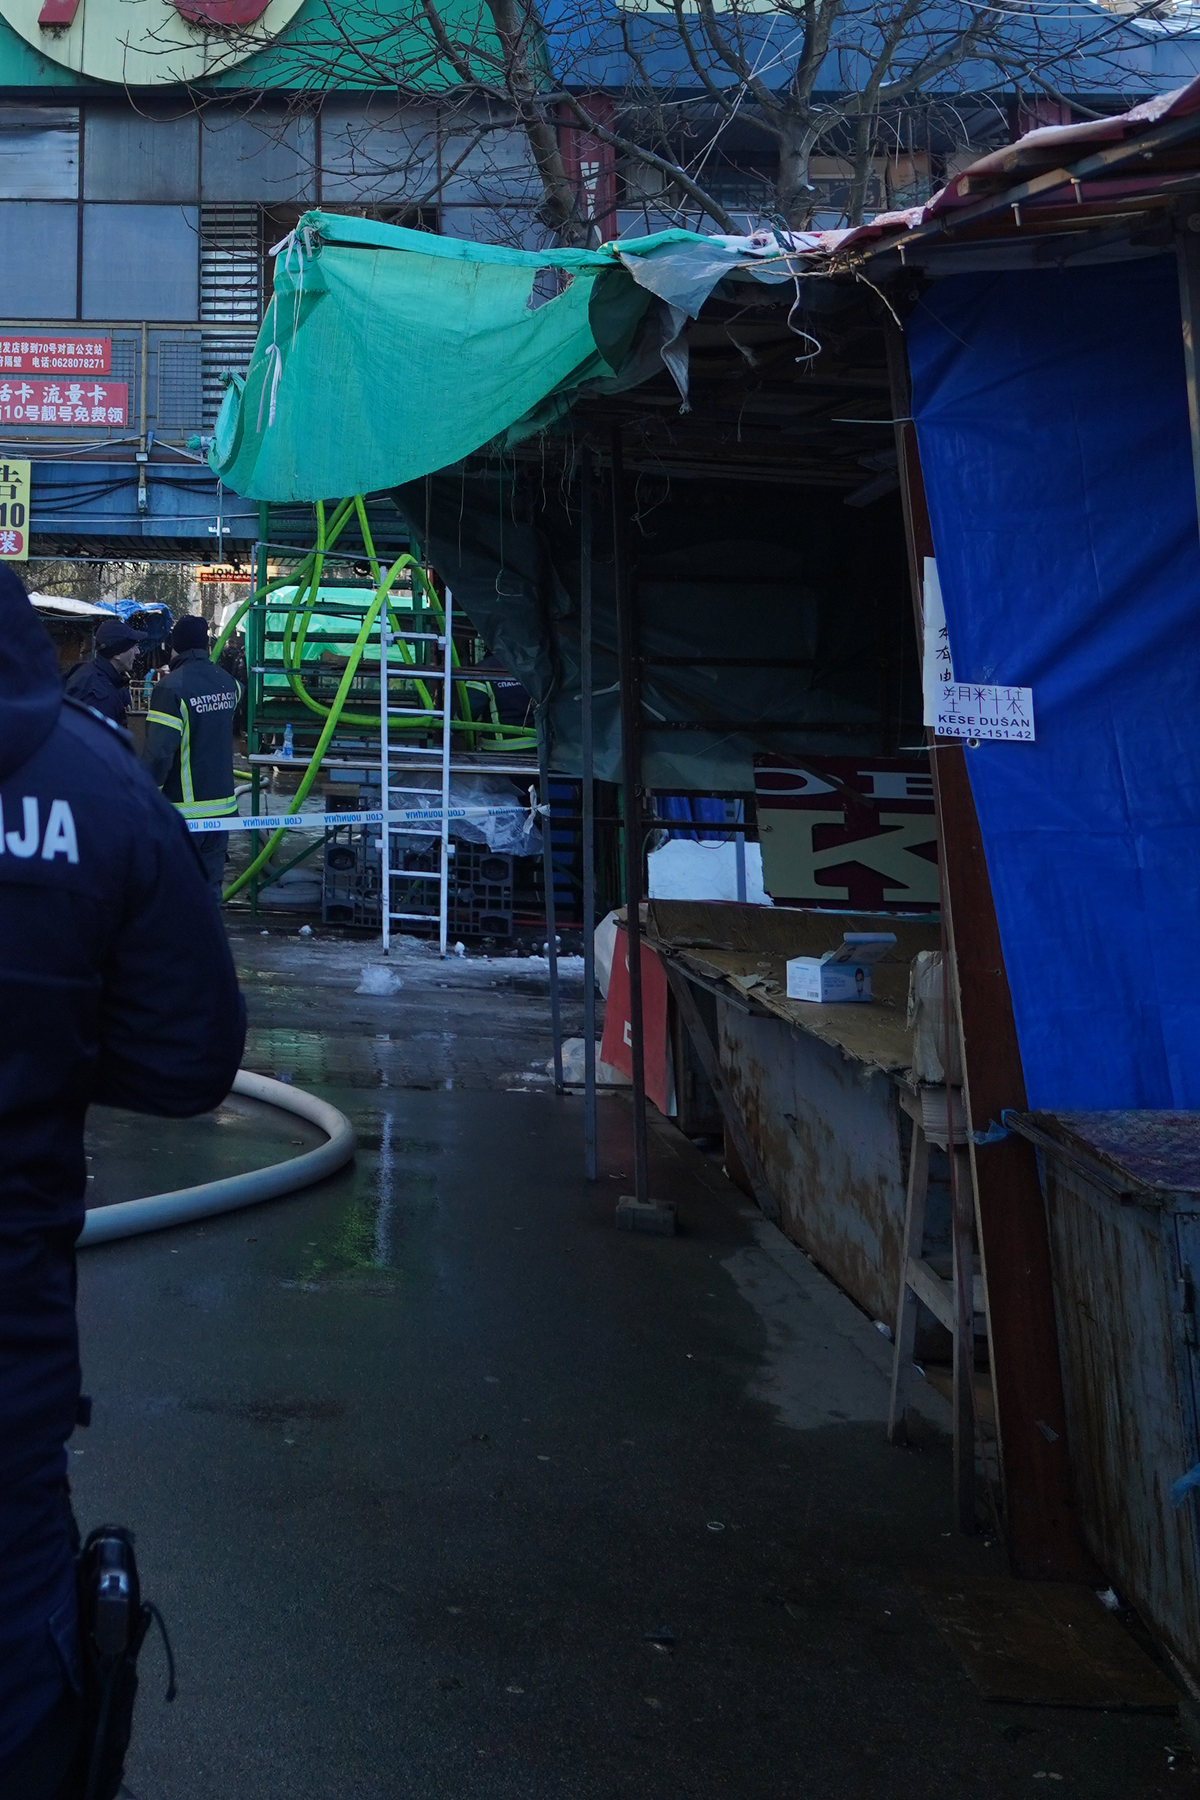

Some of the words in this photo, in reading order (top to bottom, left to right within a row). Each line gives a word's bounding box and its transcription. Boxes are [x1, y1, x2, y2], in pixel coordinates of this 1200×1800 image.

[32, 356, 105, 369] 电话:0628078271
[42, 383, 108, 406] 流量卡
[938, 714, 975, 725] KESE
[979, 714, 1030, 728] DUŠAN
[938, 726, 1032, 739] 064-12-151-42
[366, 813, 384, 821] СТОП
[405, 810, 443, 819] ПОЛИЦИЈА
[447, 809, 466, 817] СТОП
[242, 817, 280, 827] ПОЛИЦИЈА
[284, 817, 302, 825] СТОП
[324, 814, 362, 823] ПОЛИЦИЈА
[203, 820, 221, 829] СТОП
